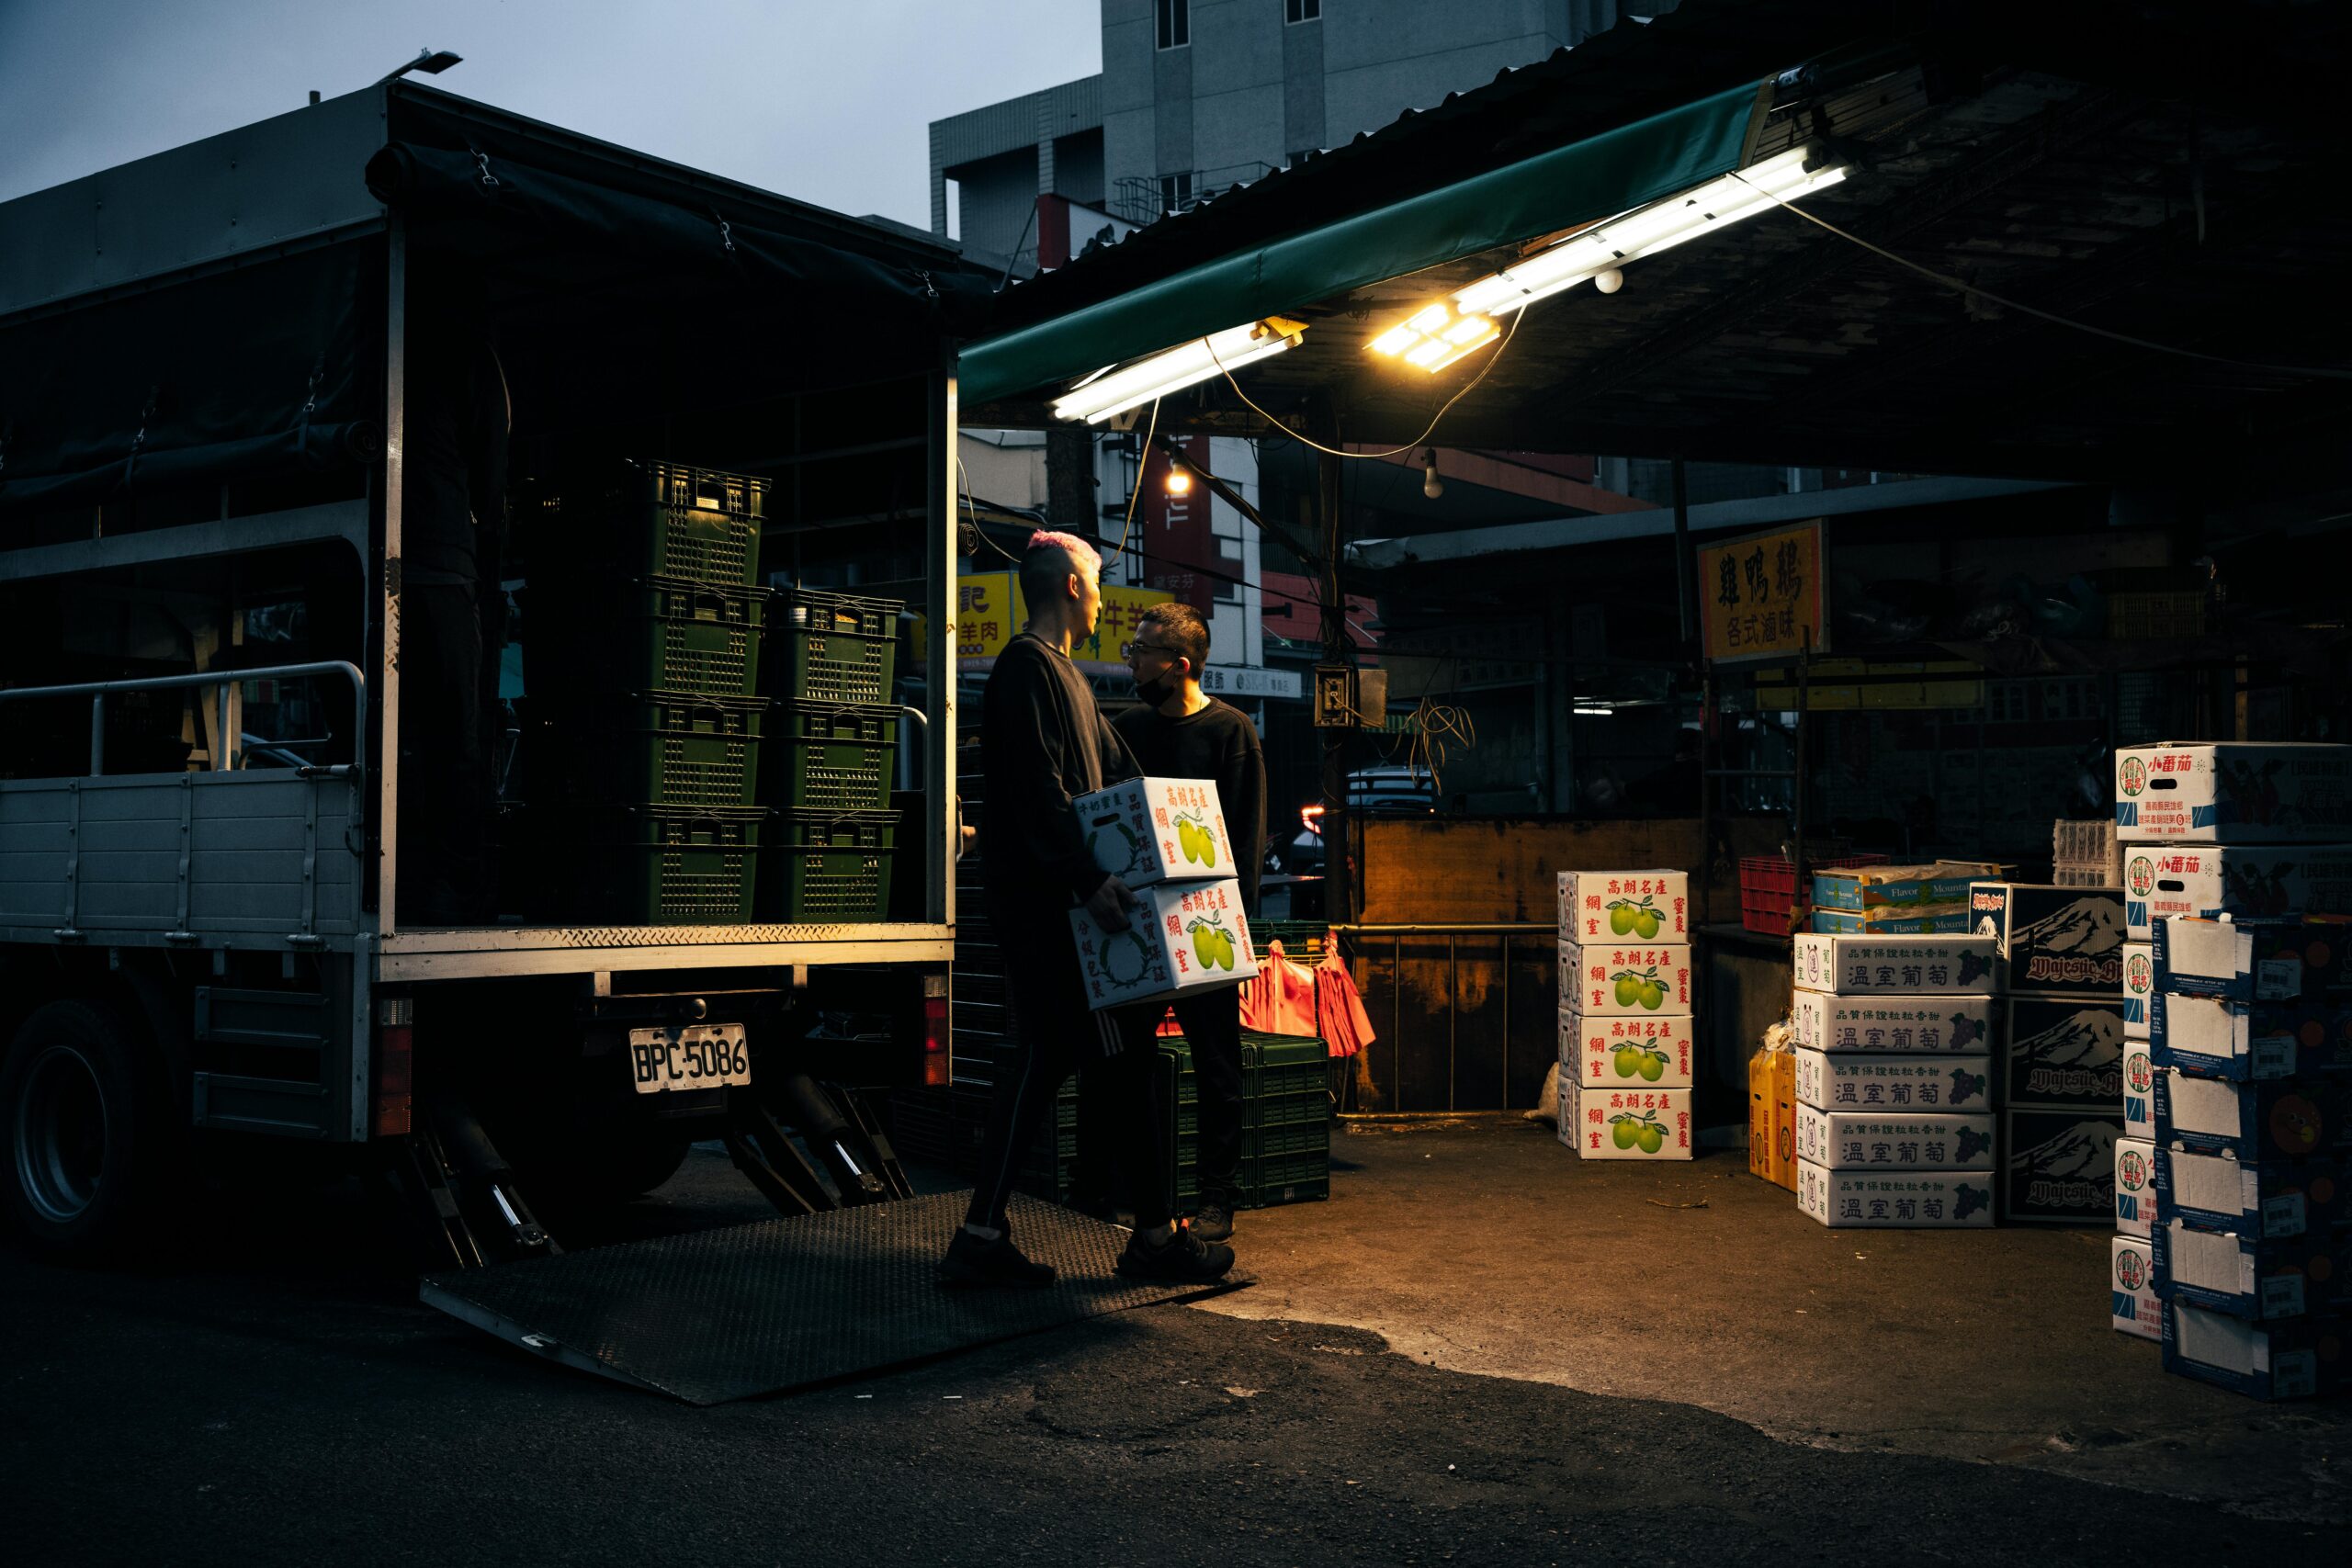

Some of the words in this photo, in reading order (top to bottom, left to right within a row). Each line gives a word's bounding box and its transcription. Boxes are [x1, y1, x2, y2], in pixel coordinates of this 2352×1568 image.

[960, 586, 989, 613] 記
[961, 621, 999, 641] 羊肉
[1726, 611, 1794, 648] 各式滷味
[2148, 755, 2193, 773] 小蕃茄
[1166, 786, 1209, 808] 高朗名產
[2156, 856, 2200, 873] 小蕃茄
[1608, 879, 1668, 895] 高朗名產
[1892, 887, 1918, 897] Flavor
[1181, 887, 1228, 913] 高朗名產
[1586, 896, 1600, 935] 網室
[1673, 897, 1685, 933] 蜜棗
[1894, 923, 1920, 934] Flavor
[1612, 951, 1671, 966] 高朗名產
[2027, 956, 2098, 983] Majestic
[1590, 966, 1606, 1007] 網室
[1677, 968, 1689, 1005] 蜜棗
[1849, 964, 1948, 987] 溫室葡萄
[1611, 1021, 1671, 1037] 高朗名產
[1837, 1027, 1940, 1050] 溫室葡萄
[1589, 1037, 1605, 1077] 網室
[1678, 1039, 1690, 1077] 蜜棗
[1836, 1082, 1940, 1104] 溫室葡萄
[2027, 1068, 2098, 1097] Majestic
[1610, 1093, 1670, 1110] 高朗名產
[1588, 1109, 1603, 1149] 網室
[1677, 1111, 1689, 1148] 蜜棗
[1843, 1141, 1946, 1163] 溫室葡萄
[2027, 1181, 2098, 1208] Majestic
[1840, 1198, 1949, 1220] 溫室葡萄
